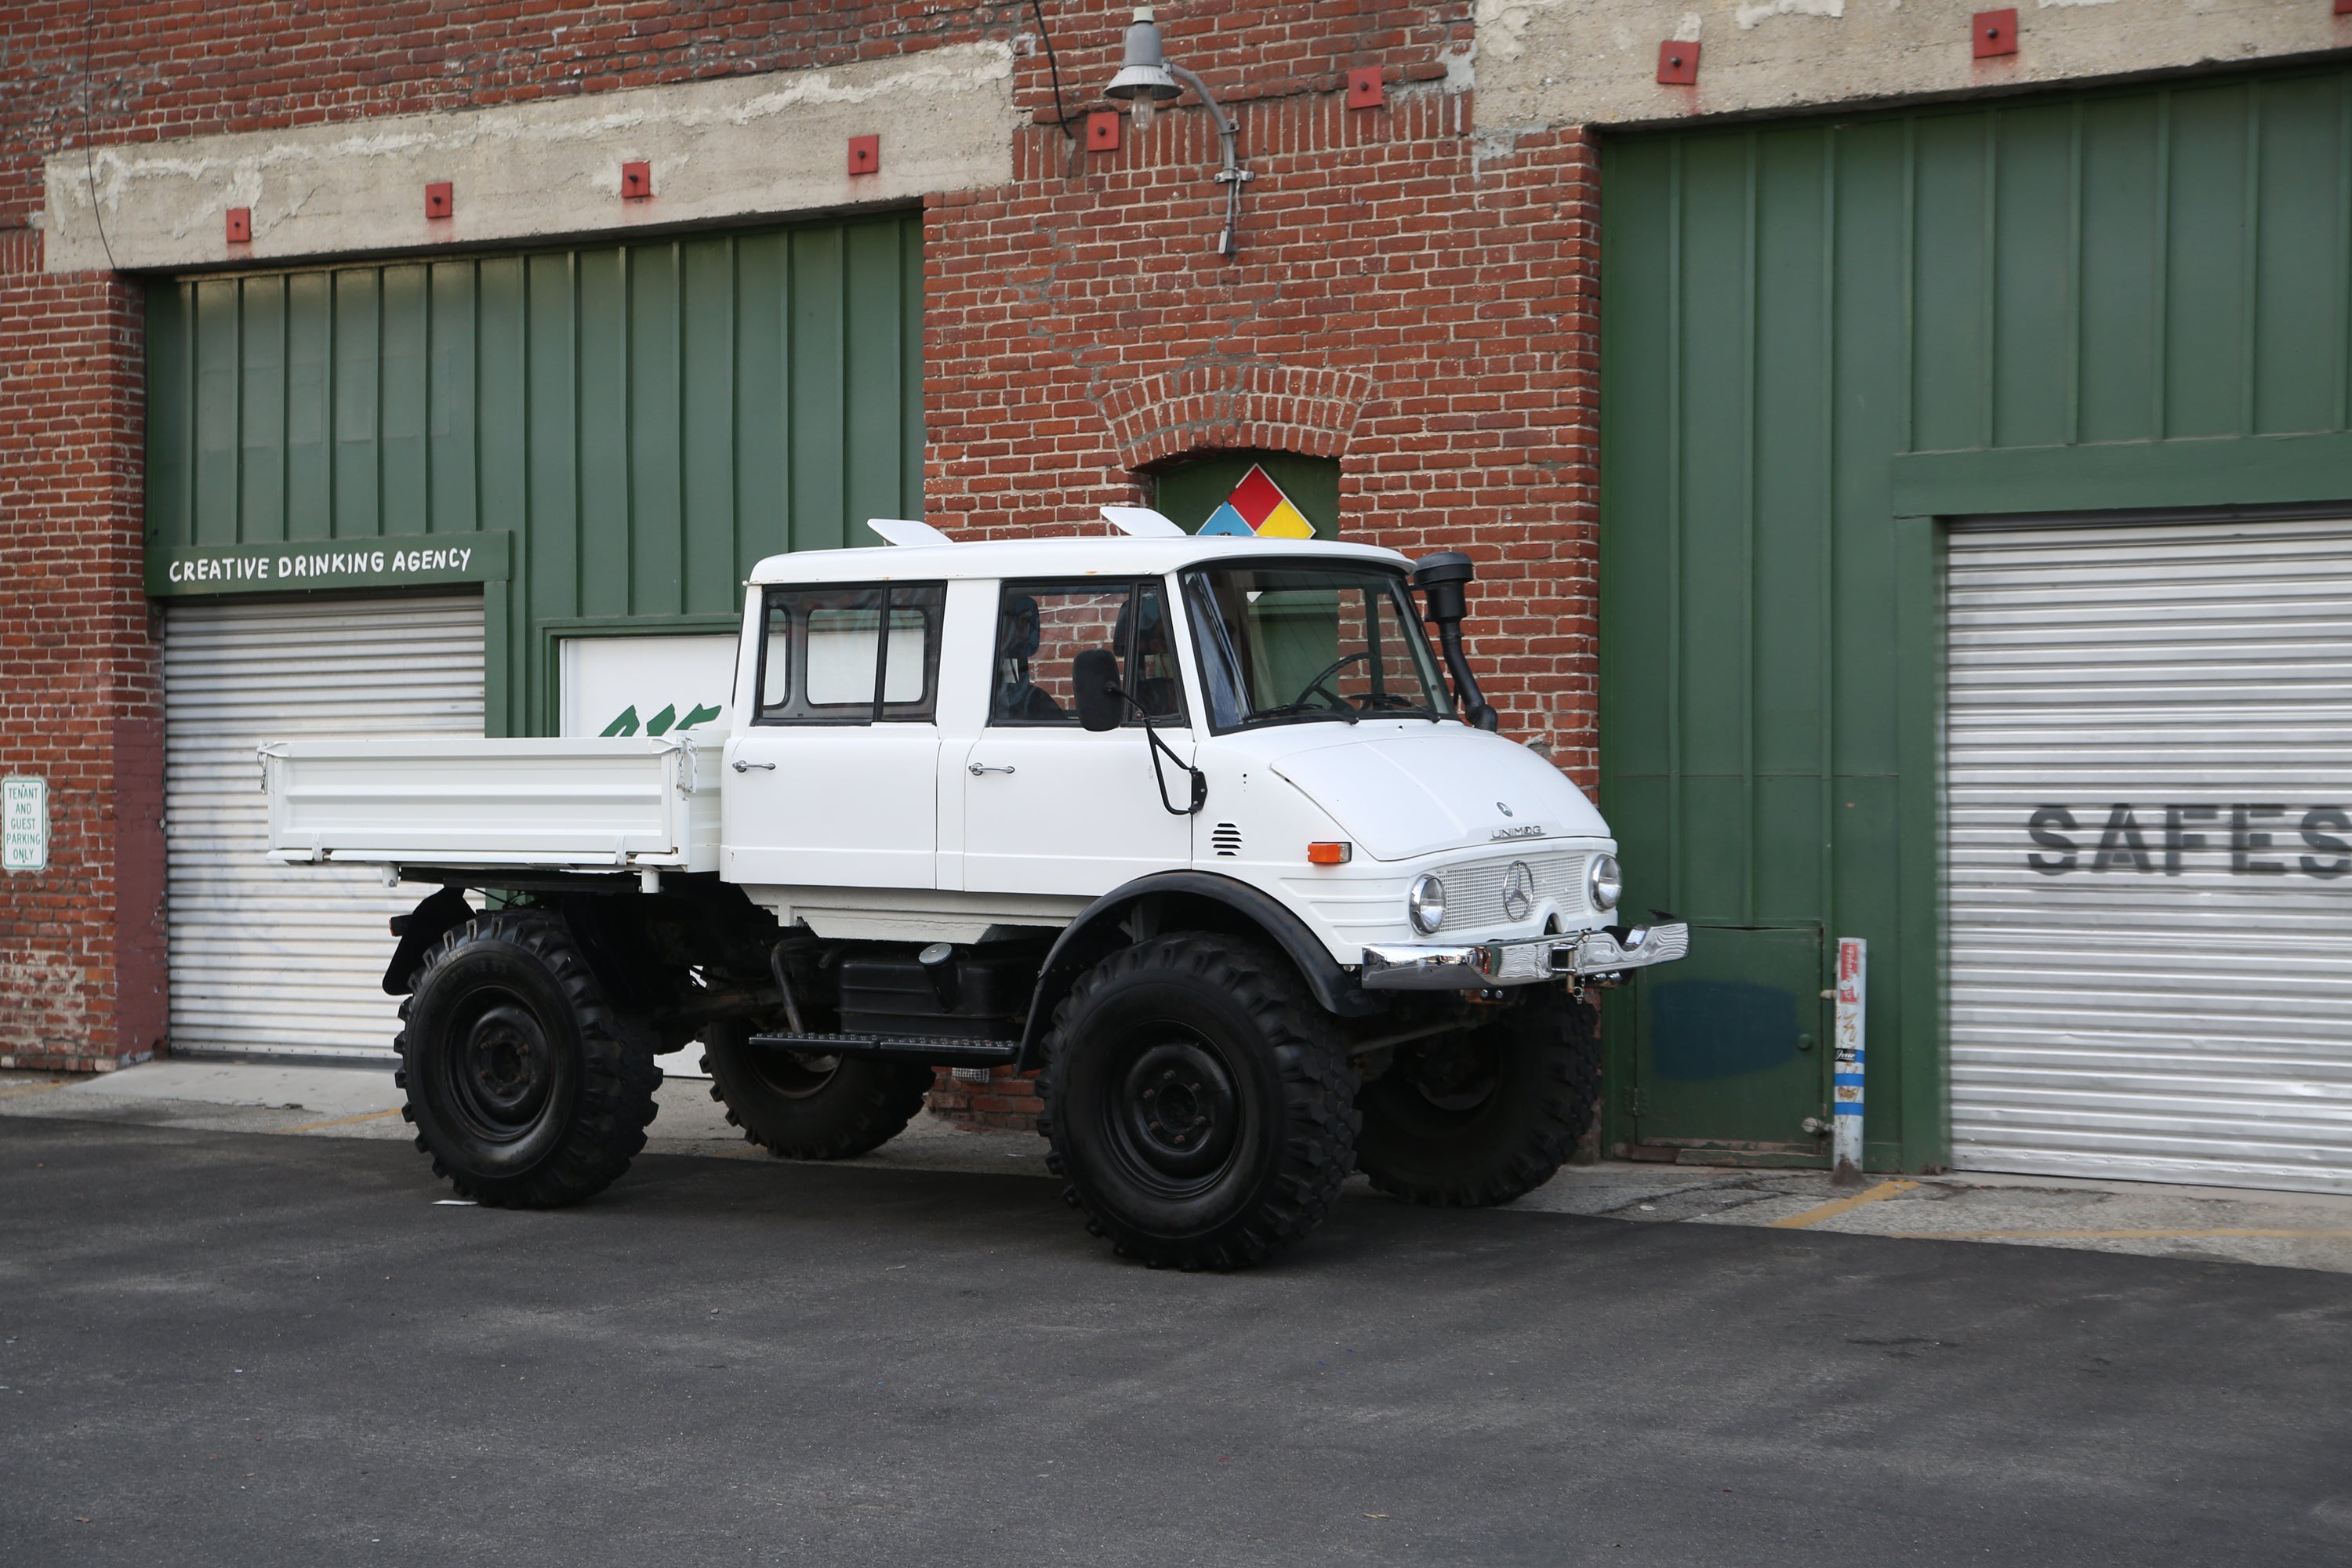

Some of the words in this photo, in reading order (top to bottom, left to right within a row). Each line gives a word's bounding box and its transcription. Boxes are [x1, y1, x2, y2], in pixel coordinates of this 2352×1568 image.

[169, 557, 270, 583] CREATIVE
[278, 551, 384, 578] DRINKING
[391, 547, 472, 573] AGENCY
[9, 788, 38, 800] TENANT
[15, 803, 32, 815] AND
[10, 818, 36, 830] GUEST
[1491, 826, 1542, 838] UNIMOG
[6, 833, 41, 846] PARKING
[2027, 804, 2352, 880] SAFES
[13, 848, 34, 861] ONLY
